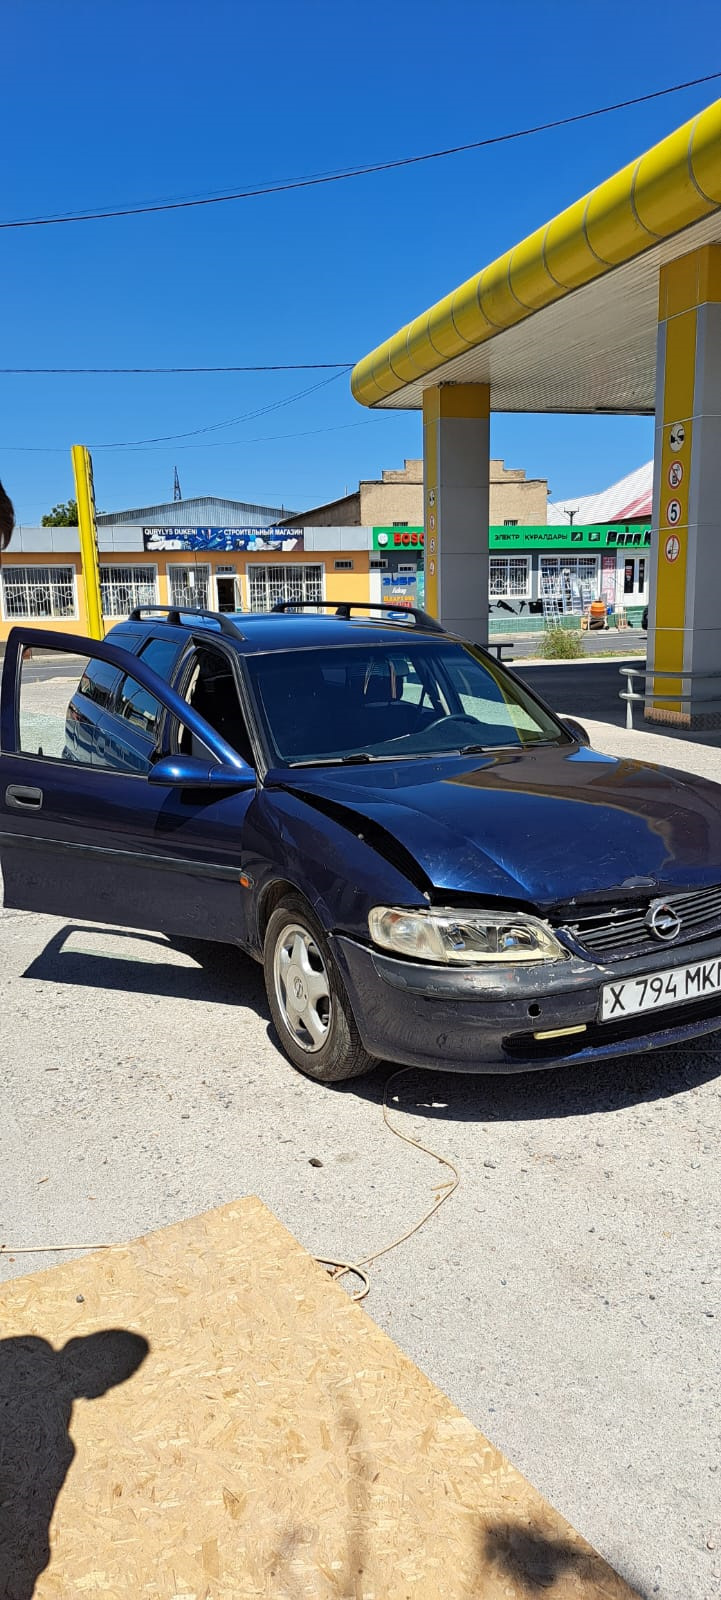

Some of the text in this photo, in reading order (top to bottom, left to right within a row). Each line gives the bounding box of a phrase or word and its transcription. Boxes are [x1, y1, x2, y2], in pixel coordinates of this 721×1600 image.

[669, 503, 679, 522] 5
[144, 528, 198, 536] QURYLYS DUKENI
[223, 527, 303, 536] СТРОИТЕЛЬНЫЙ МАГАЗИН
[609, 962, 721, 1014] X 794 MK
